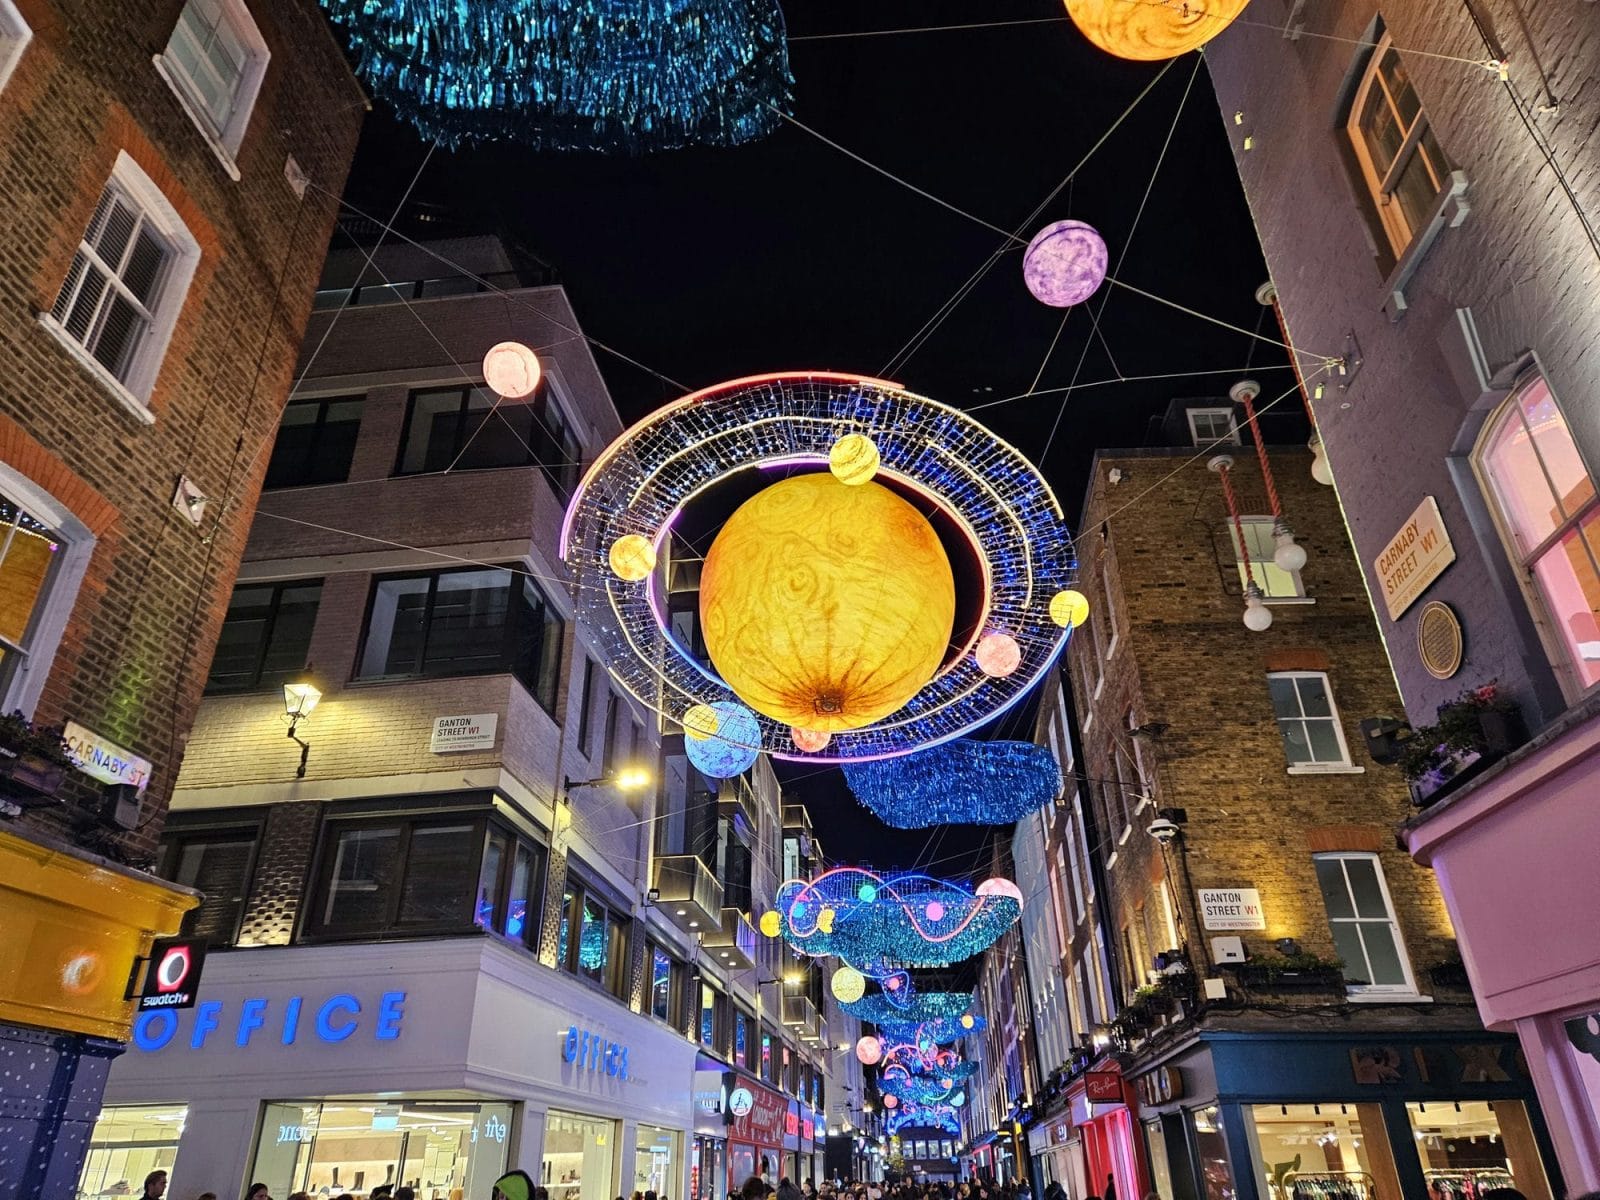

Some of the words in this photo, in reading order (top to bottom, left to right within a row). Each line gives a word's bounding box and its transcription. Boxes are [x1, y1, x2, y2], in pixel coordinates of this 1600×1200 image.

[1379, 518, 1420, 576] CARNABY
[1386, 550, 1418, 595] STREET
[1420, 527, 1439, 554] W1
[438, 727, 466, 737] STREET
[468, 726, 480, 735] W1
[439, 718, 471, 728] GANTON
[68, 736, 128, 776] CARNABY
[128, 767, 145, 787] ST
[1203, 892, 1242, 903] GANTON
[1206, 905, 1241, 916] STREET
[1244, 905, 1259, 916] W1
[143, 992, 182, 1007] swatch
[133, 991, 406, 1052] OFFICE
[565, 1024, 629, 1082] OFFICE
